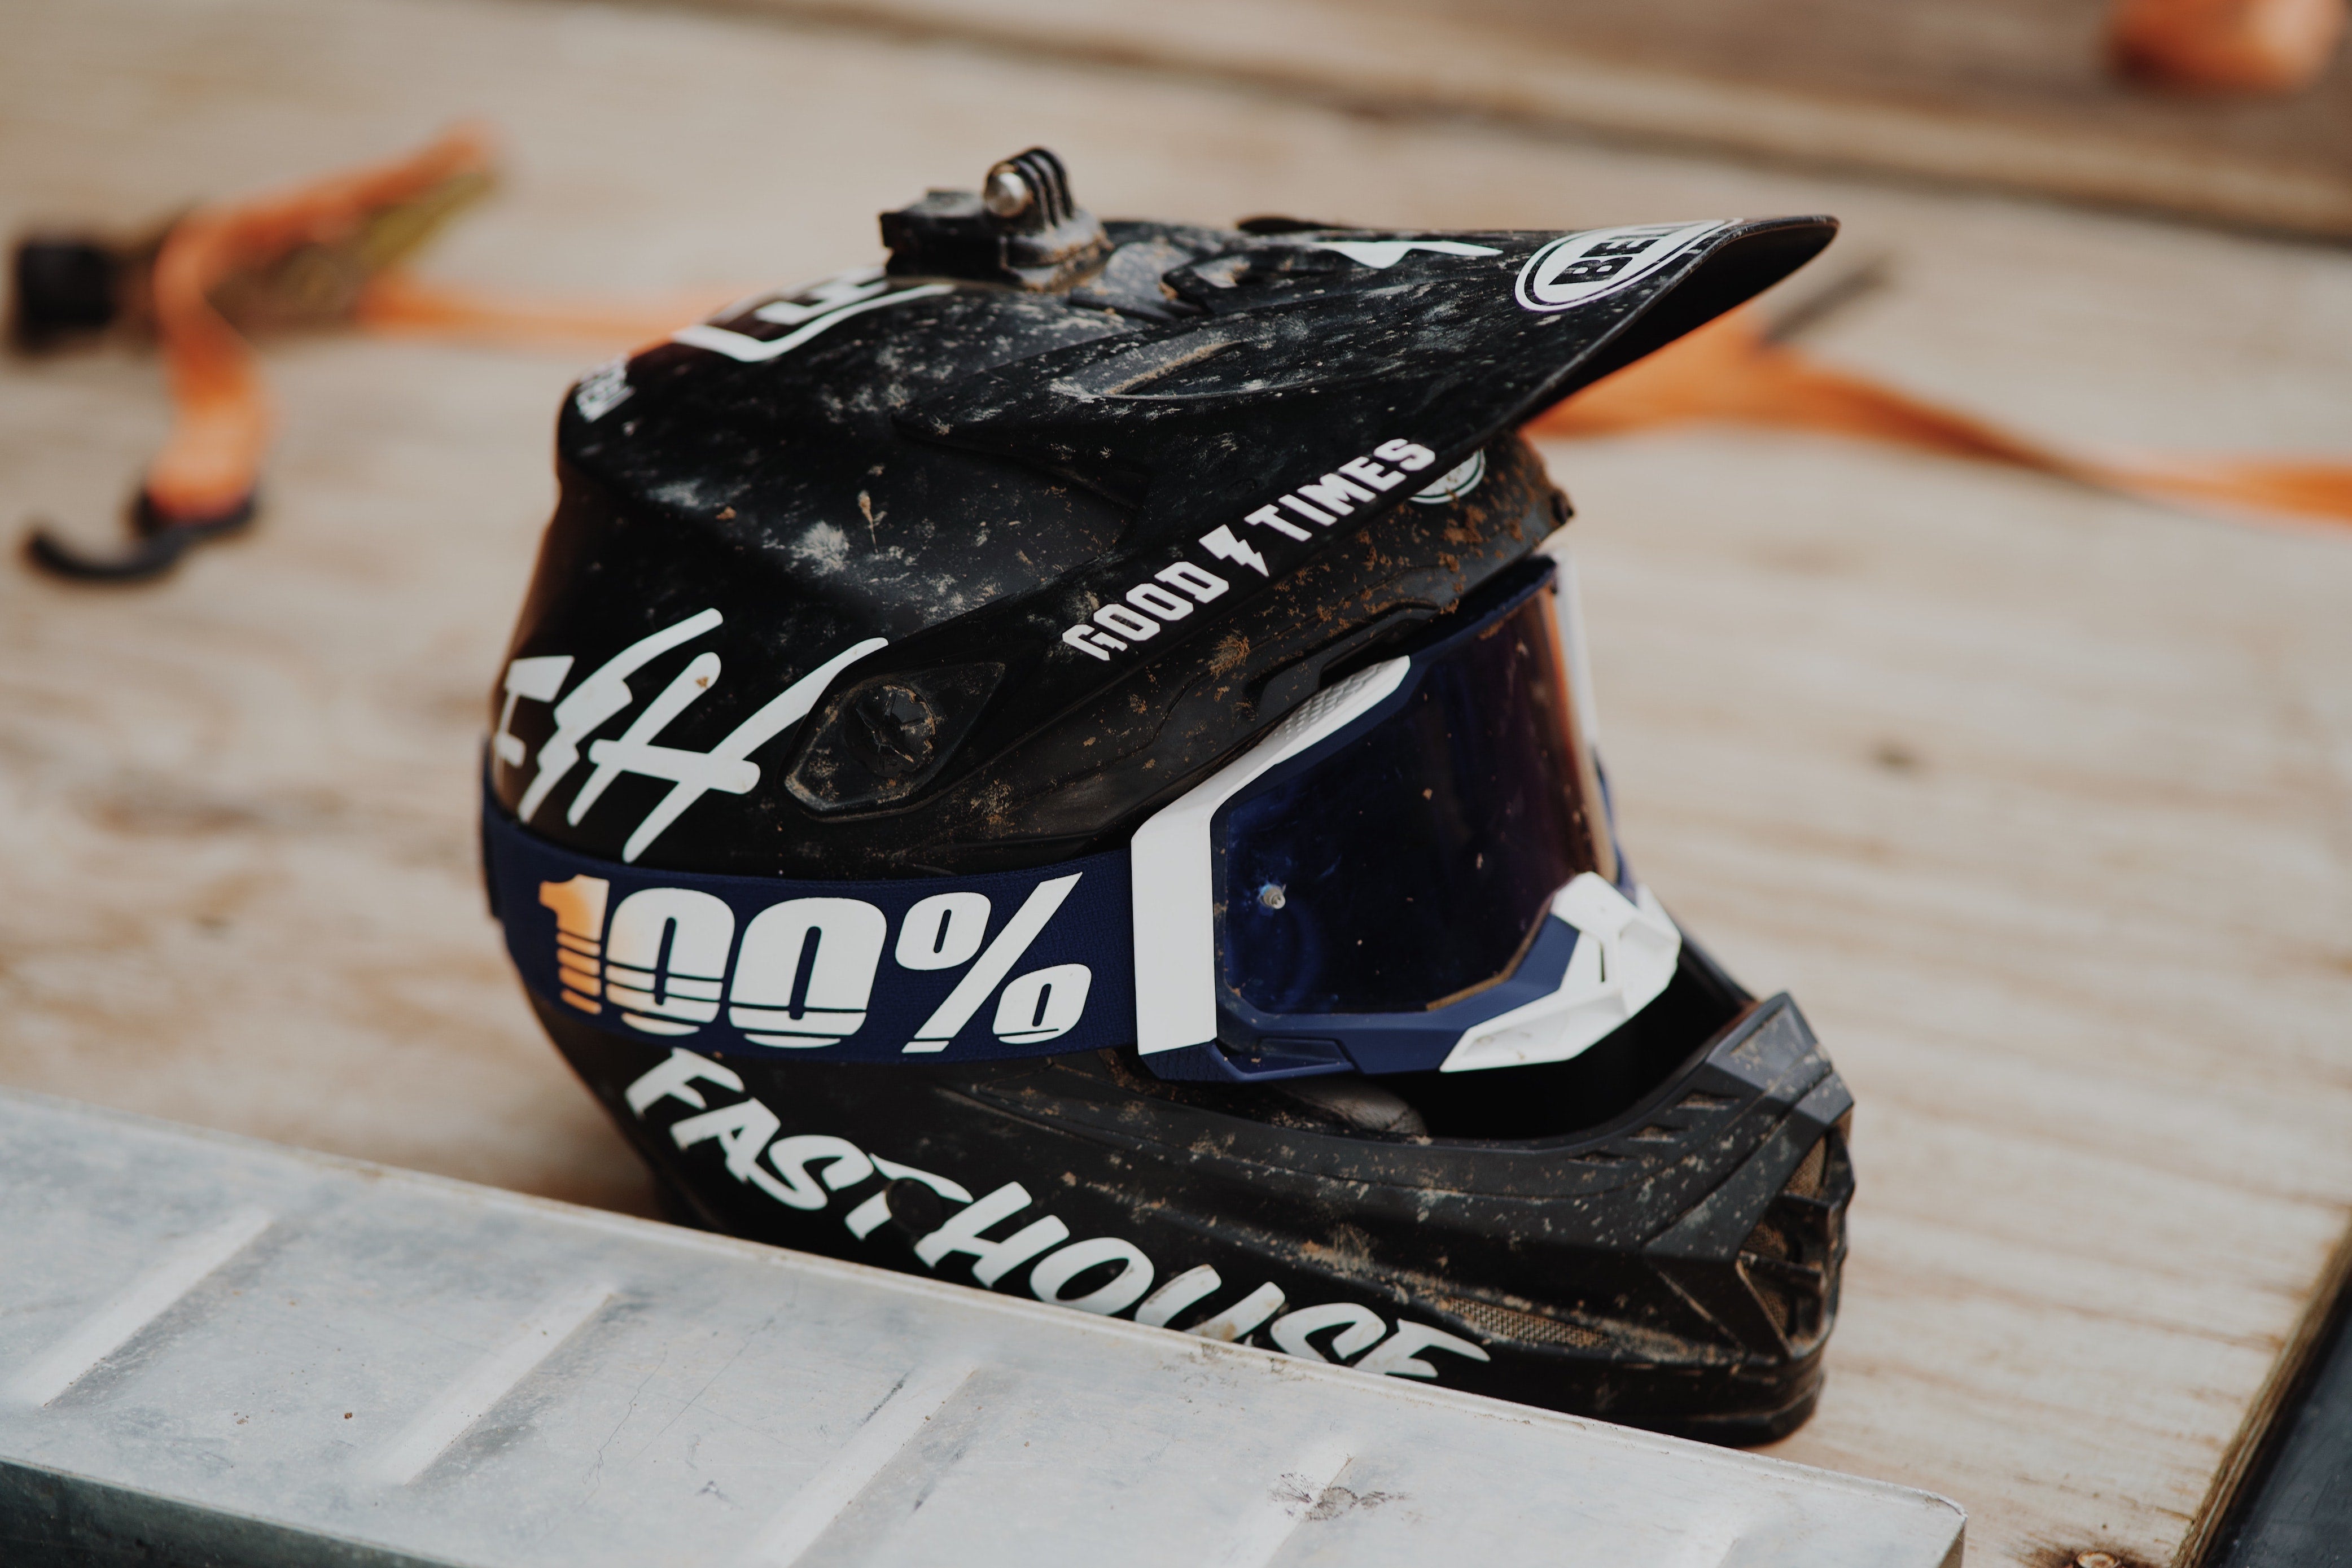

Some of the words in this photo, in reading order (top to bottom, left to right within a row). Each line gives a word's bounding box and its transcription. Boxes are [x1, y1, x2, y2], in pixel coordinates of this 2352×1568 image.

[1062, 561, 1229, 661] GOOD
[1244, 439, 1435, 542] TIMES
[538, 871, 1092, 1053] 100%
